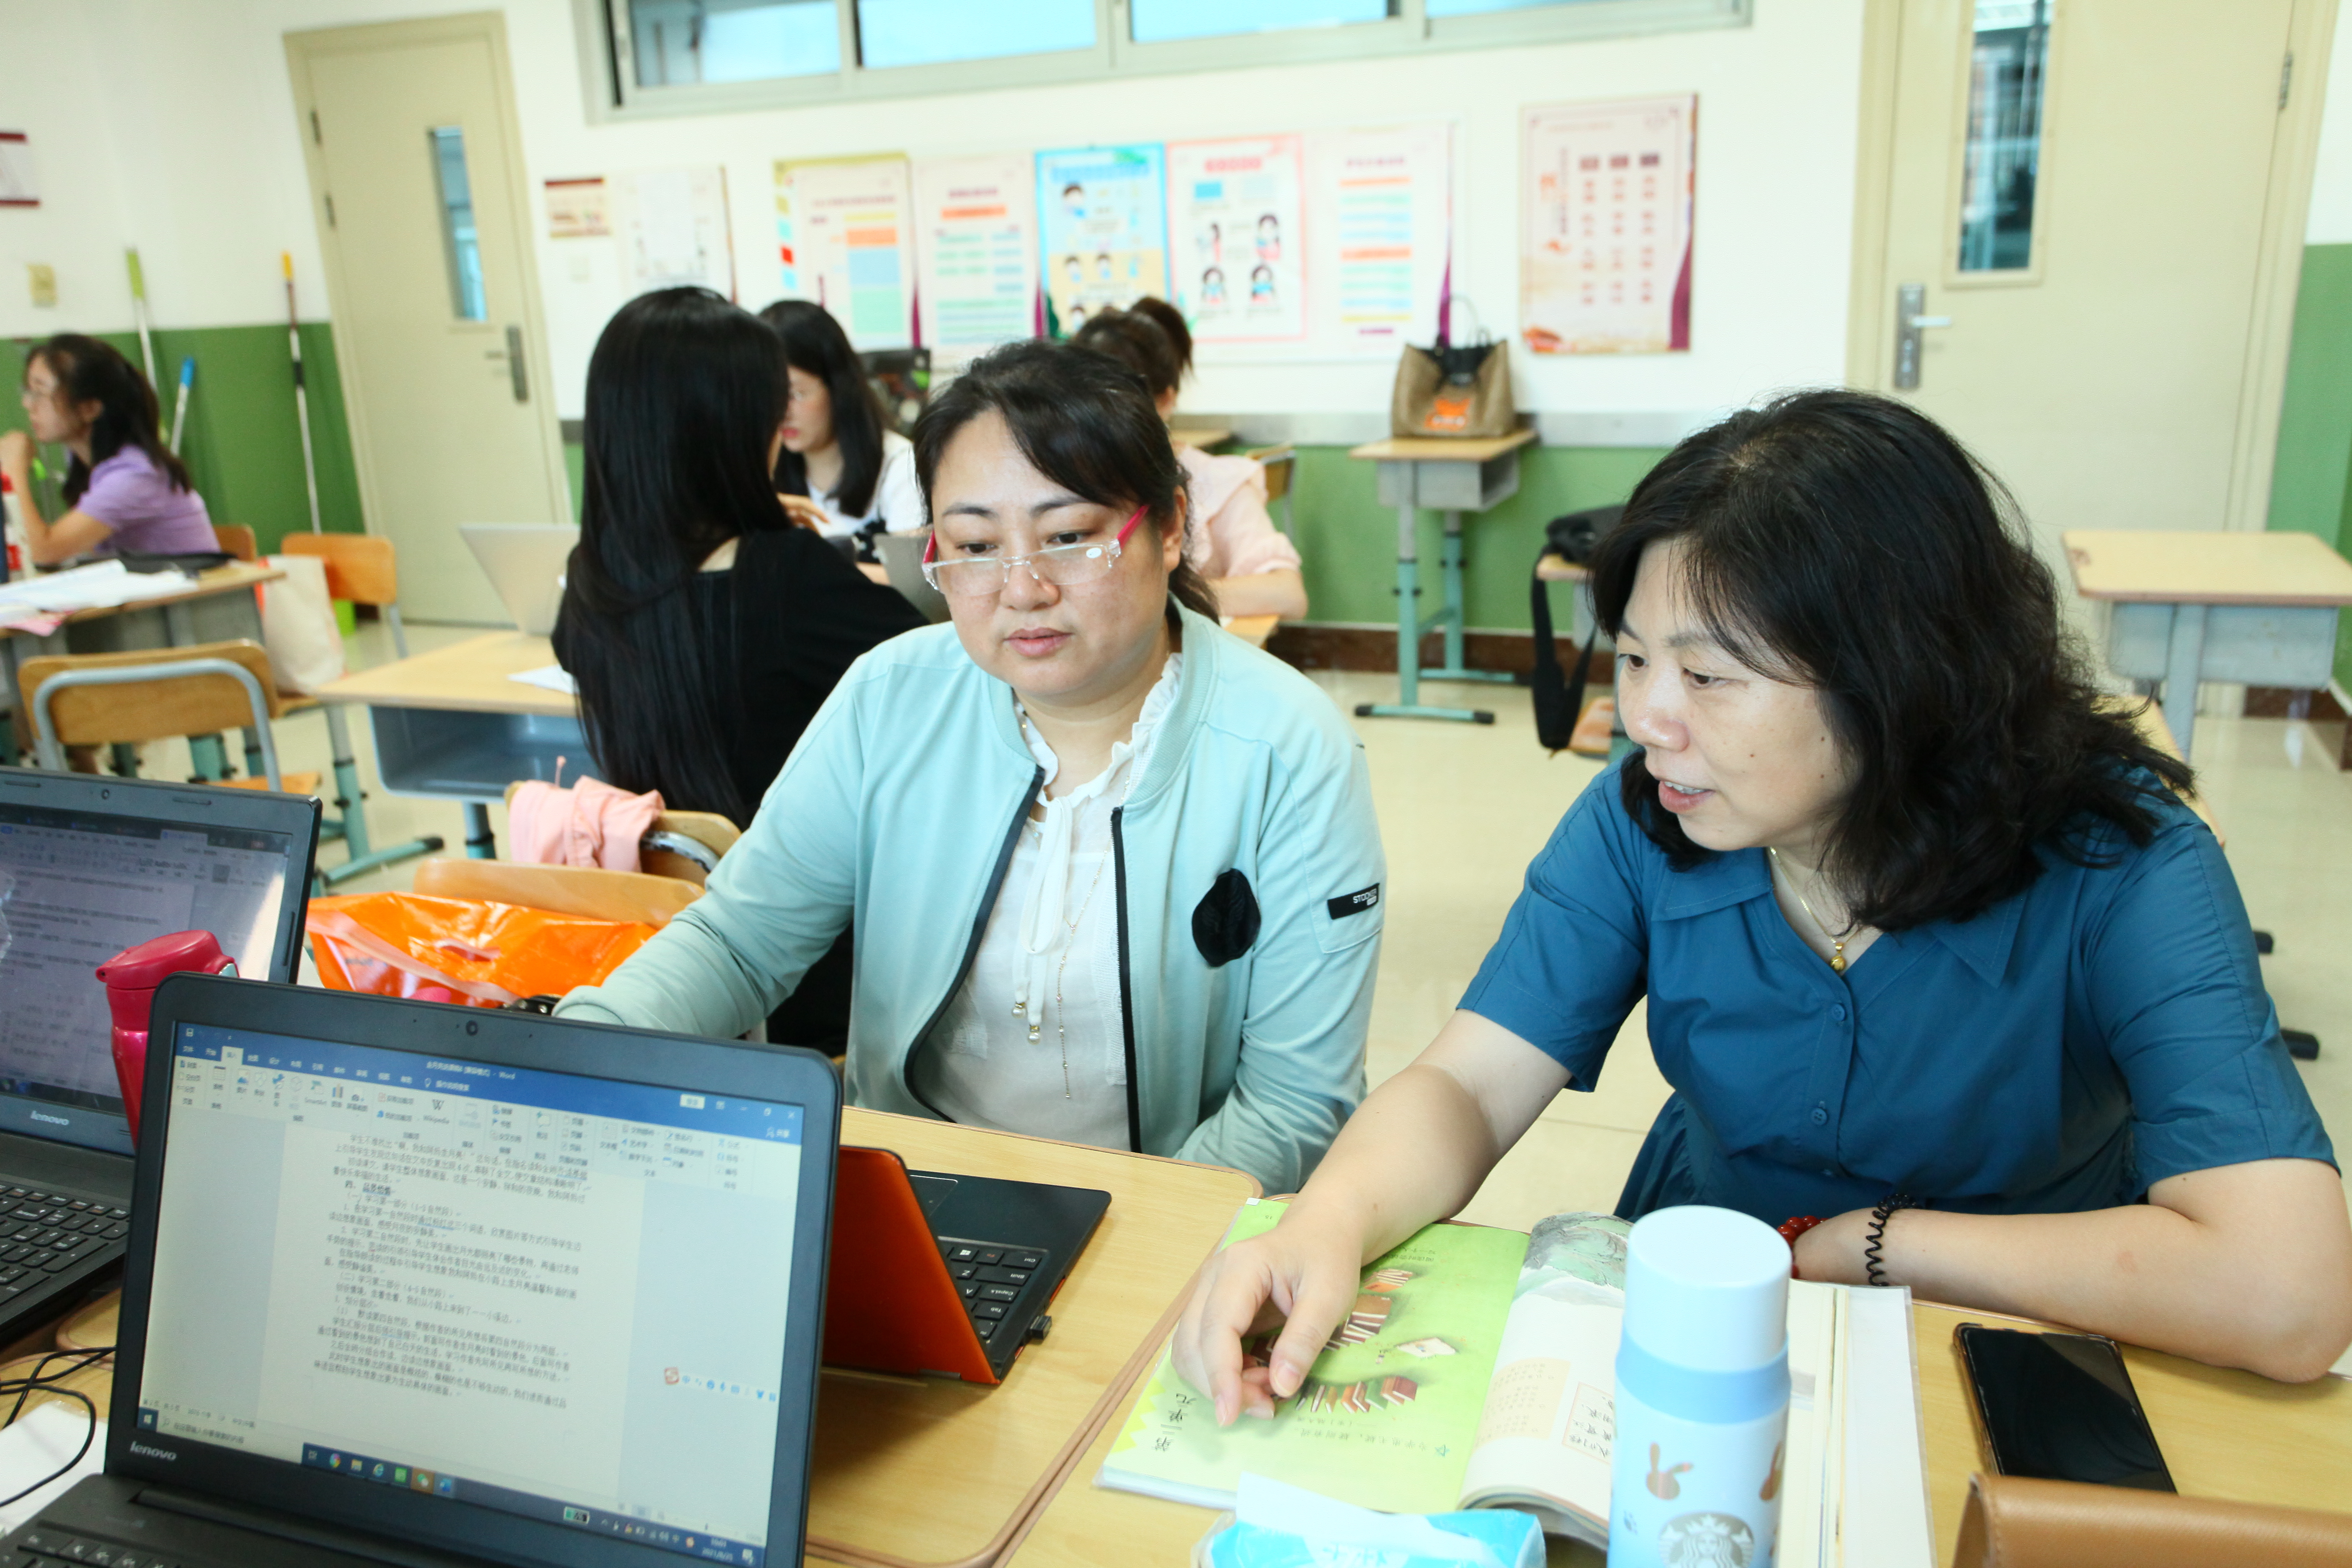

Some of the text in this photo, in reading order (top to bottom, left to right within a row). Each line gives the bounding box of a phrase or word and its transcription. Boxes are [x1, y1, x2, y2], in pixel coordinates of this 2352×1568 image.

[30, 1110, 70, 1126] lenovo
[1151, 1393, 1197, 1452] 第二单元
[130, 1440, 177, 1461] lenovo
